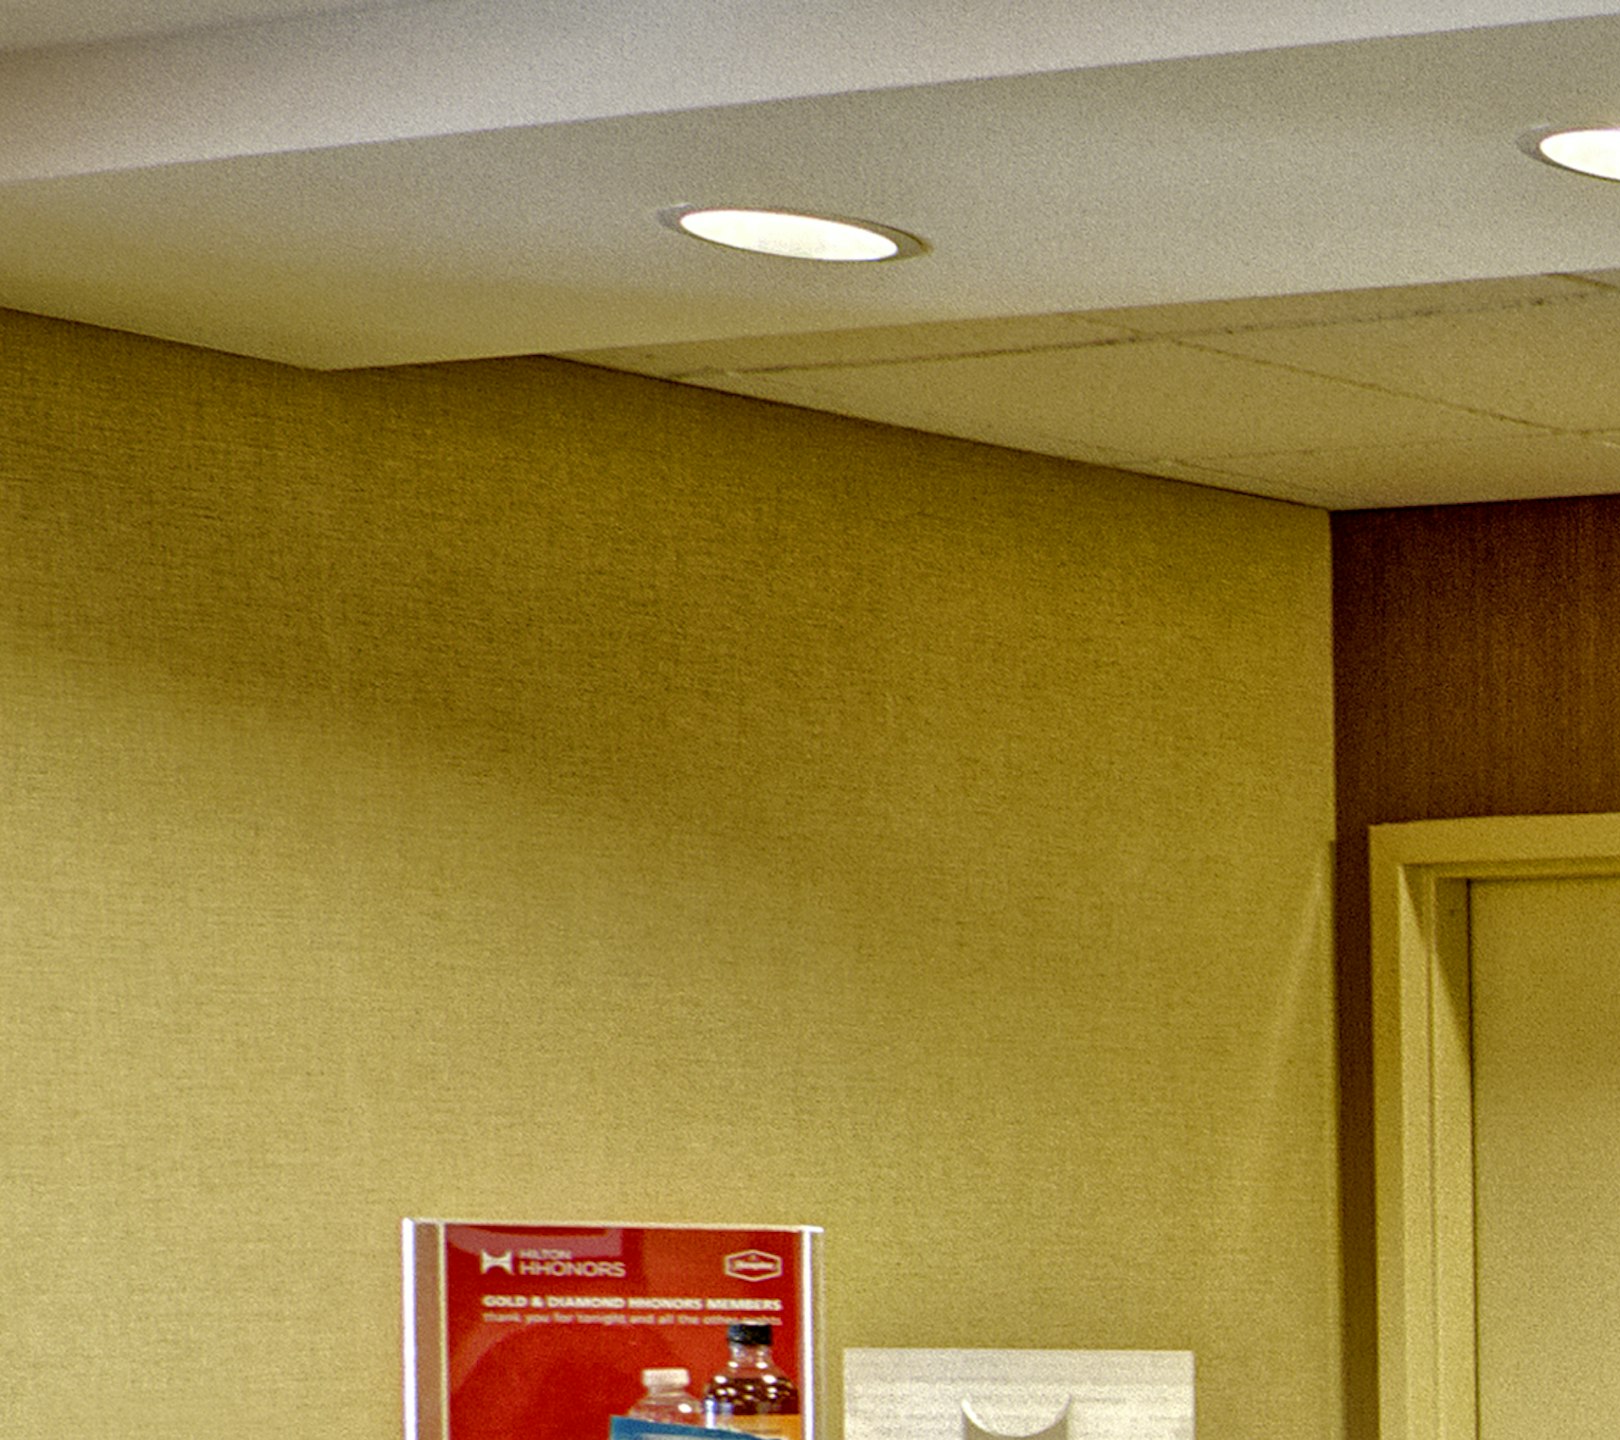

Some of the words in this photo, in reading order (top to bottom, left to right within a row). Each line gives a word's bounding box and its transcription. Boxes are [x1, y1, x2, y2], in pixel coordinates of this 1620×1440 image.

[518, 1249, 573, 1260] HILTON
[519, 1261, 627, 1278] HHONORS
[482, 1294, 529, 1308] GOLD
[546, 1295, 627, 1309] DIAMOND
[705, 1298, 783, 1311] MEMBERS
